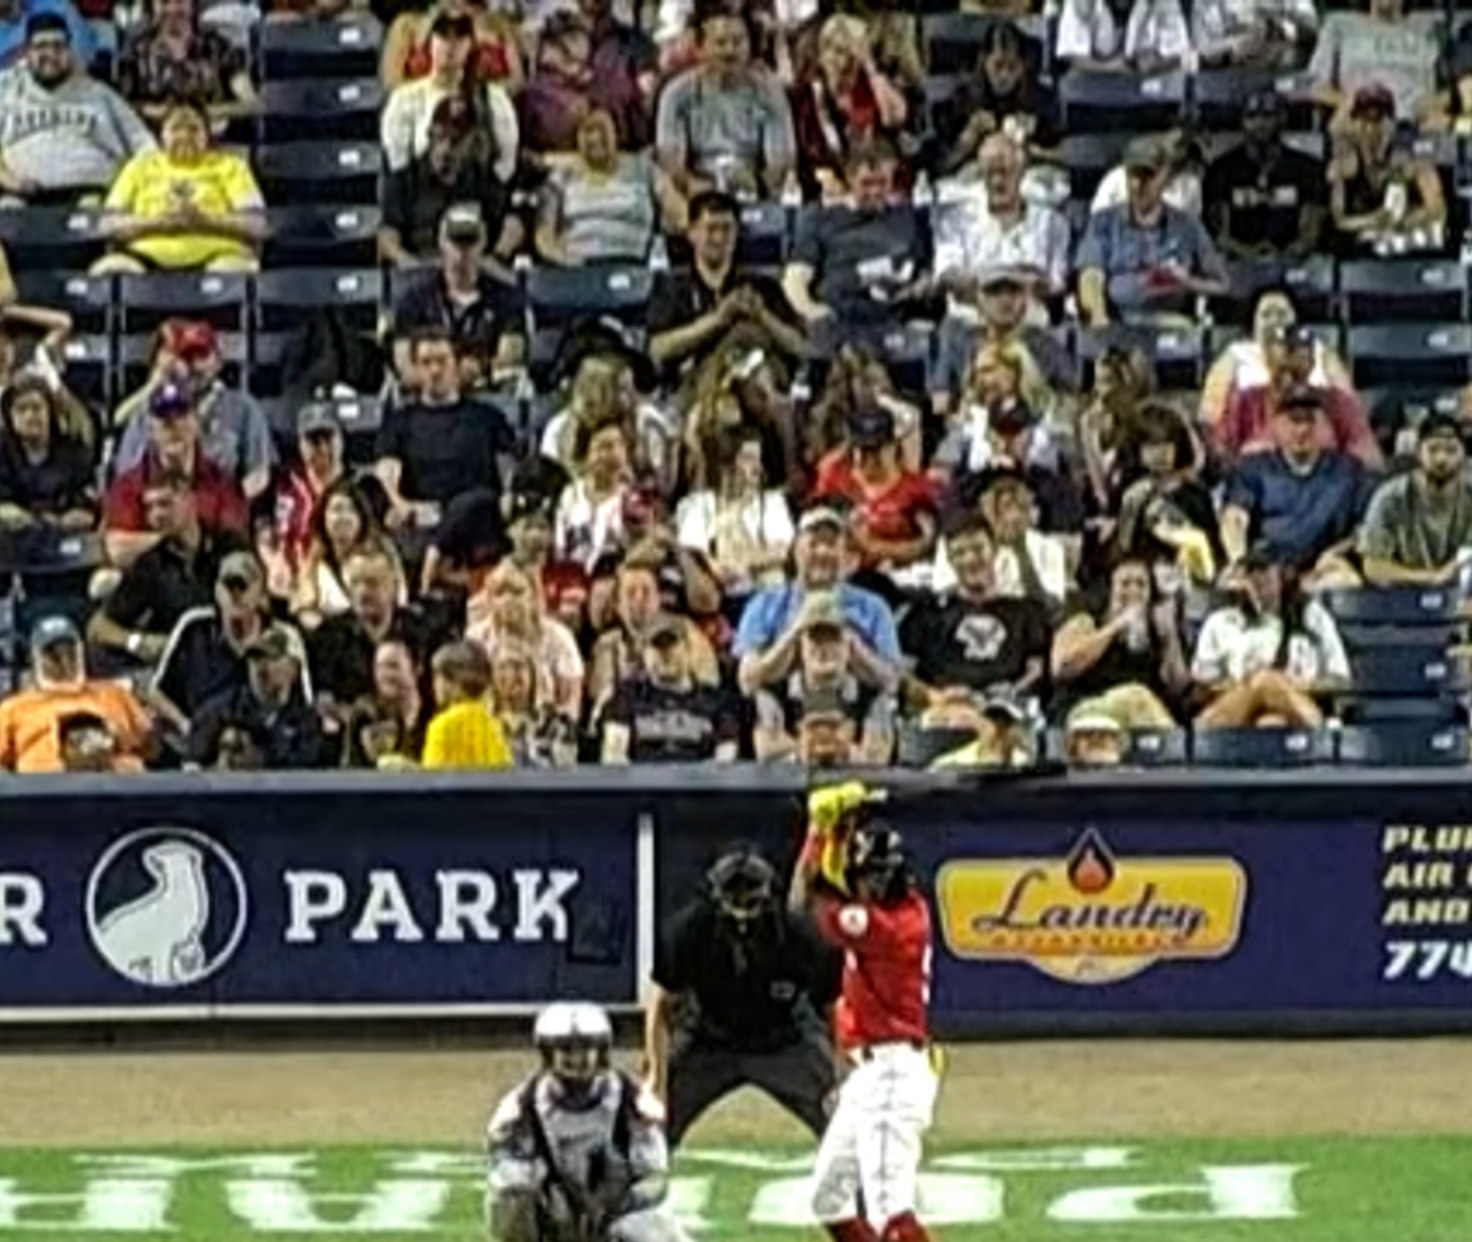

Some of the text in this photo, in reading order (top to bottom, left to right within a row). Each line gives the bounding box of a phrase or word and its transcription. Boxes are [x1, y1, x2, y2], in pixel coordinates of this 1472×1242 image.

[1383, 861, 1455, 889] AIR
[283, 869, 580, 941] PARK
[971, 870, 1210, 942] Landry
[1383, 898, 1471, 925] AND
